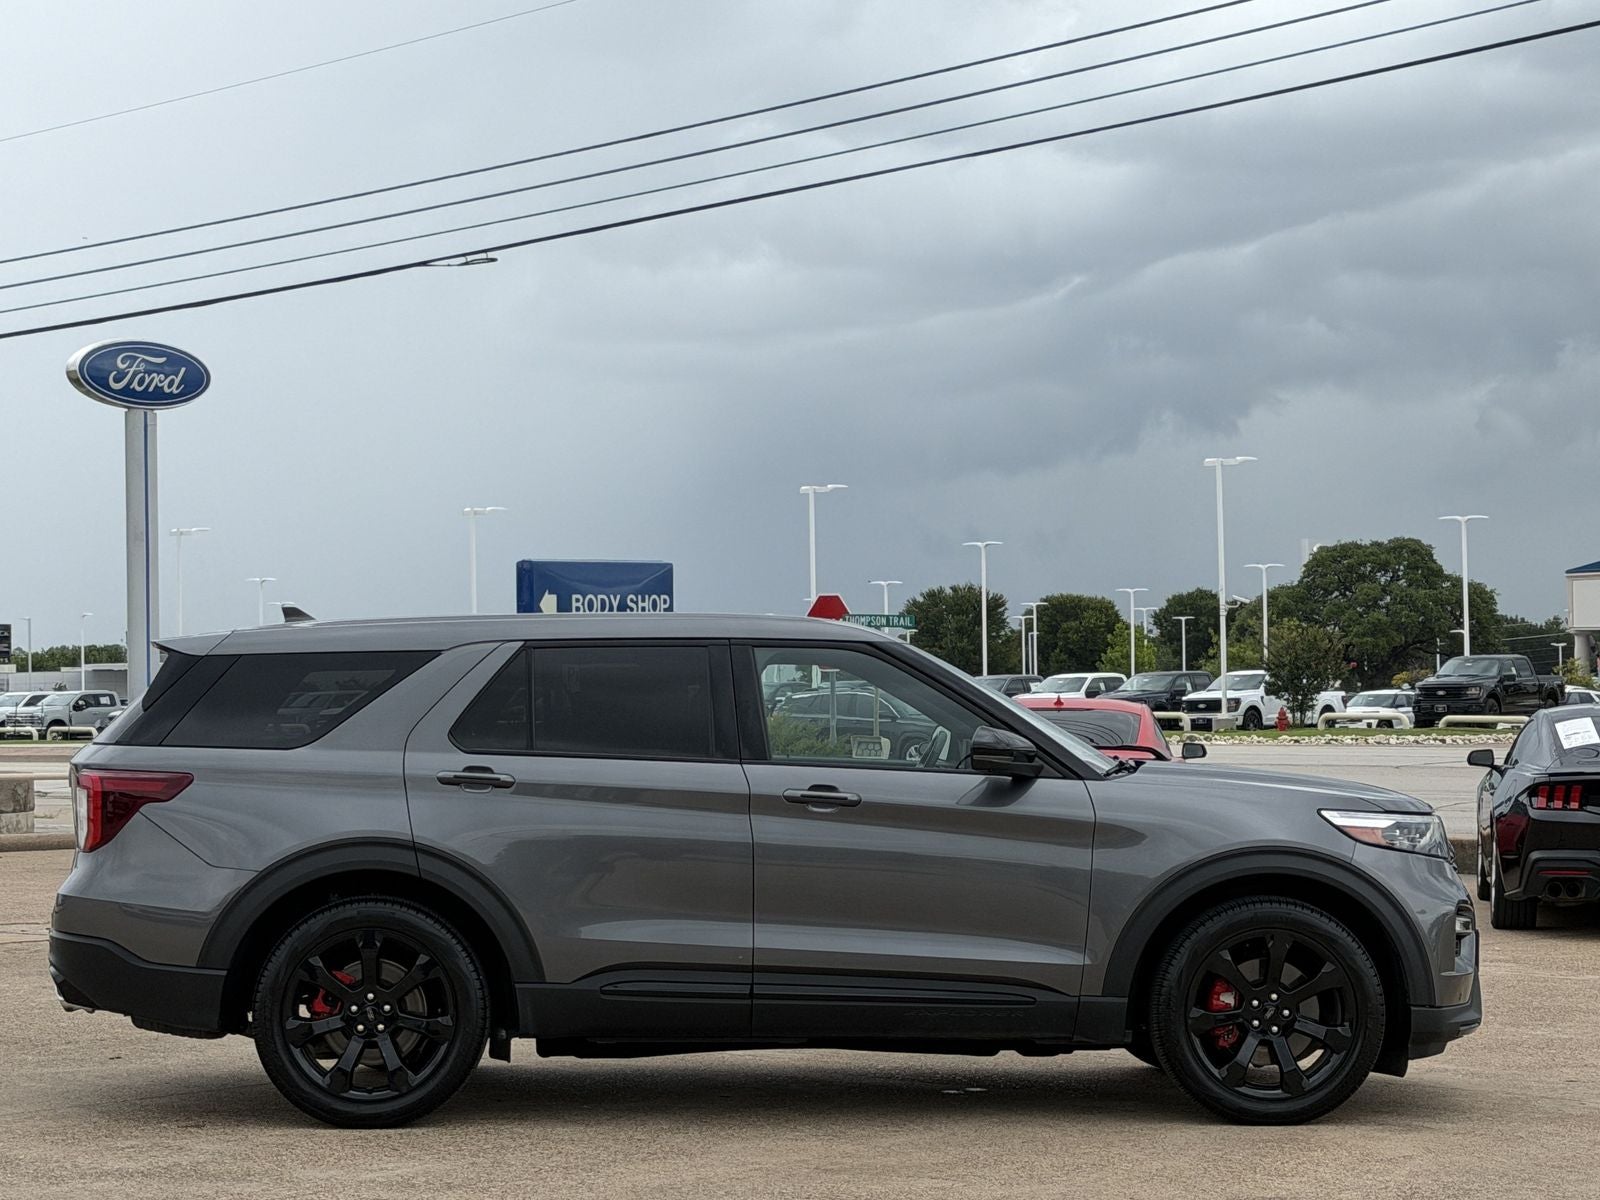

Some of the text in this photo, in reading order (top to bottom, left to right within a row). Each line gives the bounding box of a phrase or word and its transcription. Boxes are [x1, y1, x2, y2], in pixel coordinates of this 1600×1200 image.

[108, 352, 187, 394] Ford
[571, 593, 670, 613] BODY SHOP
[888, 615, 912, 626] TRAIL
